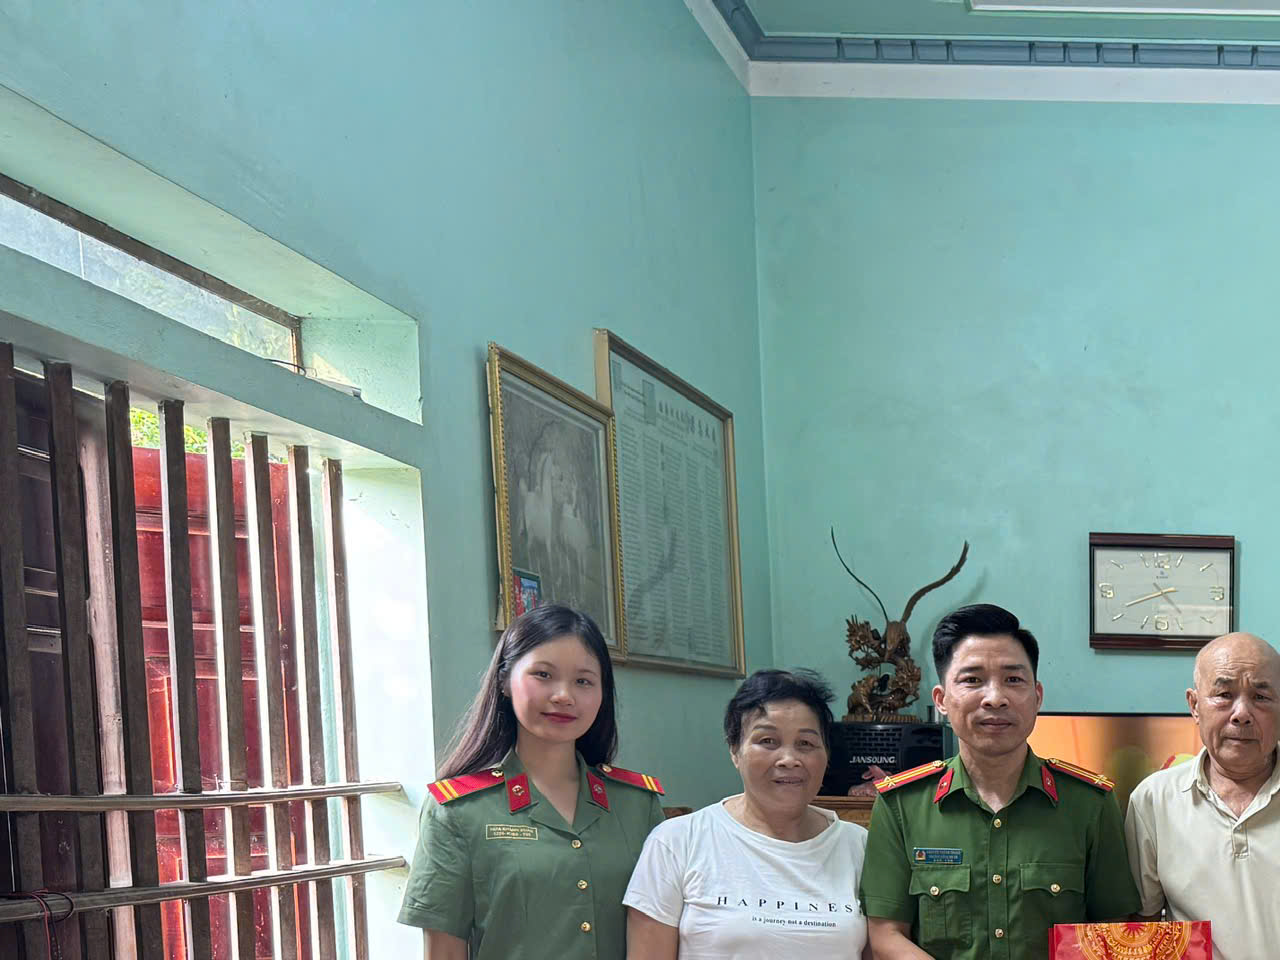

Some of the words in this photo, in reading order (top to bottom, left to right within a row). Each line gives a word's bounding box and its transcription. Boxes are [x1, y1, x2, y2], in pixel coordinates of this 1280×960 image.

[1099, 583, 1115, 598] 9
[1209, 586, 1225, 601] 3
[849, 756, 895, 764] JANSOUNG
[717, 896, 862, 914] HAPPINES
[763, 916, 786, 926] journey
[804, 919, 837, 928] destination
